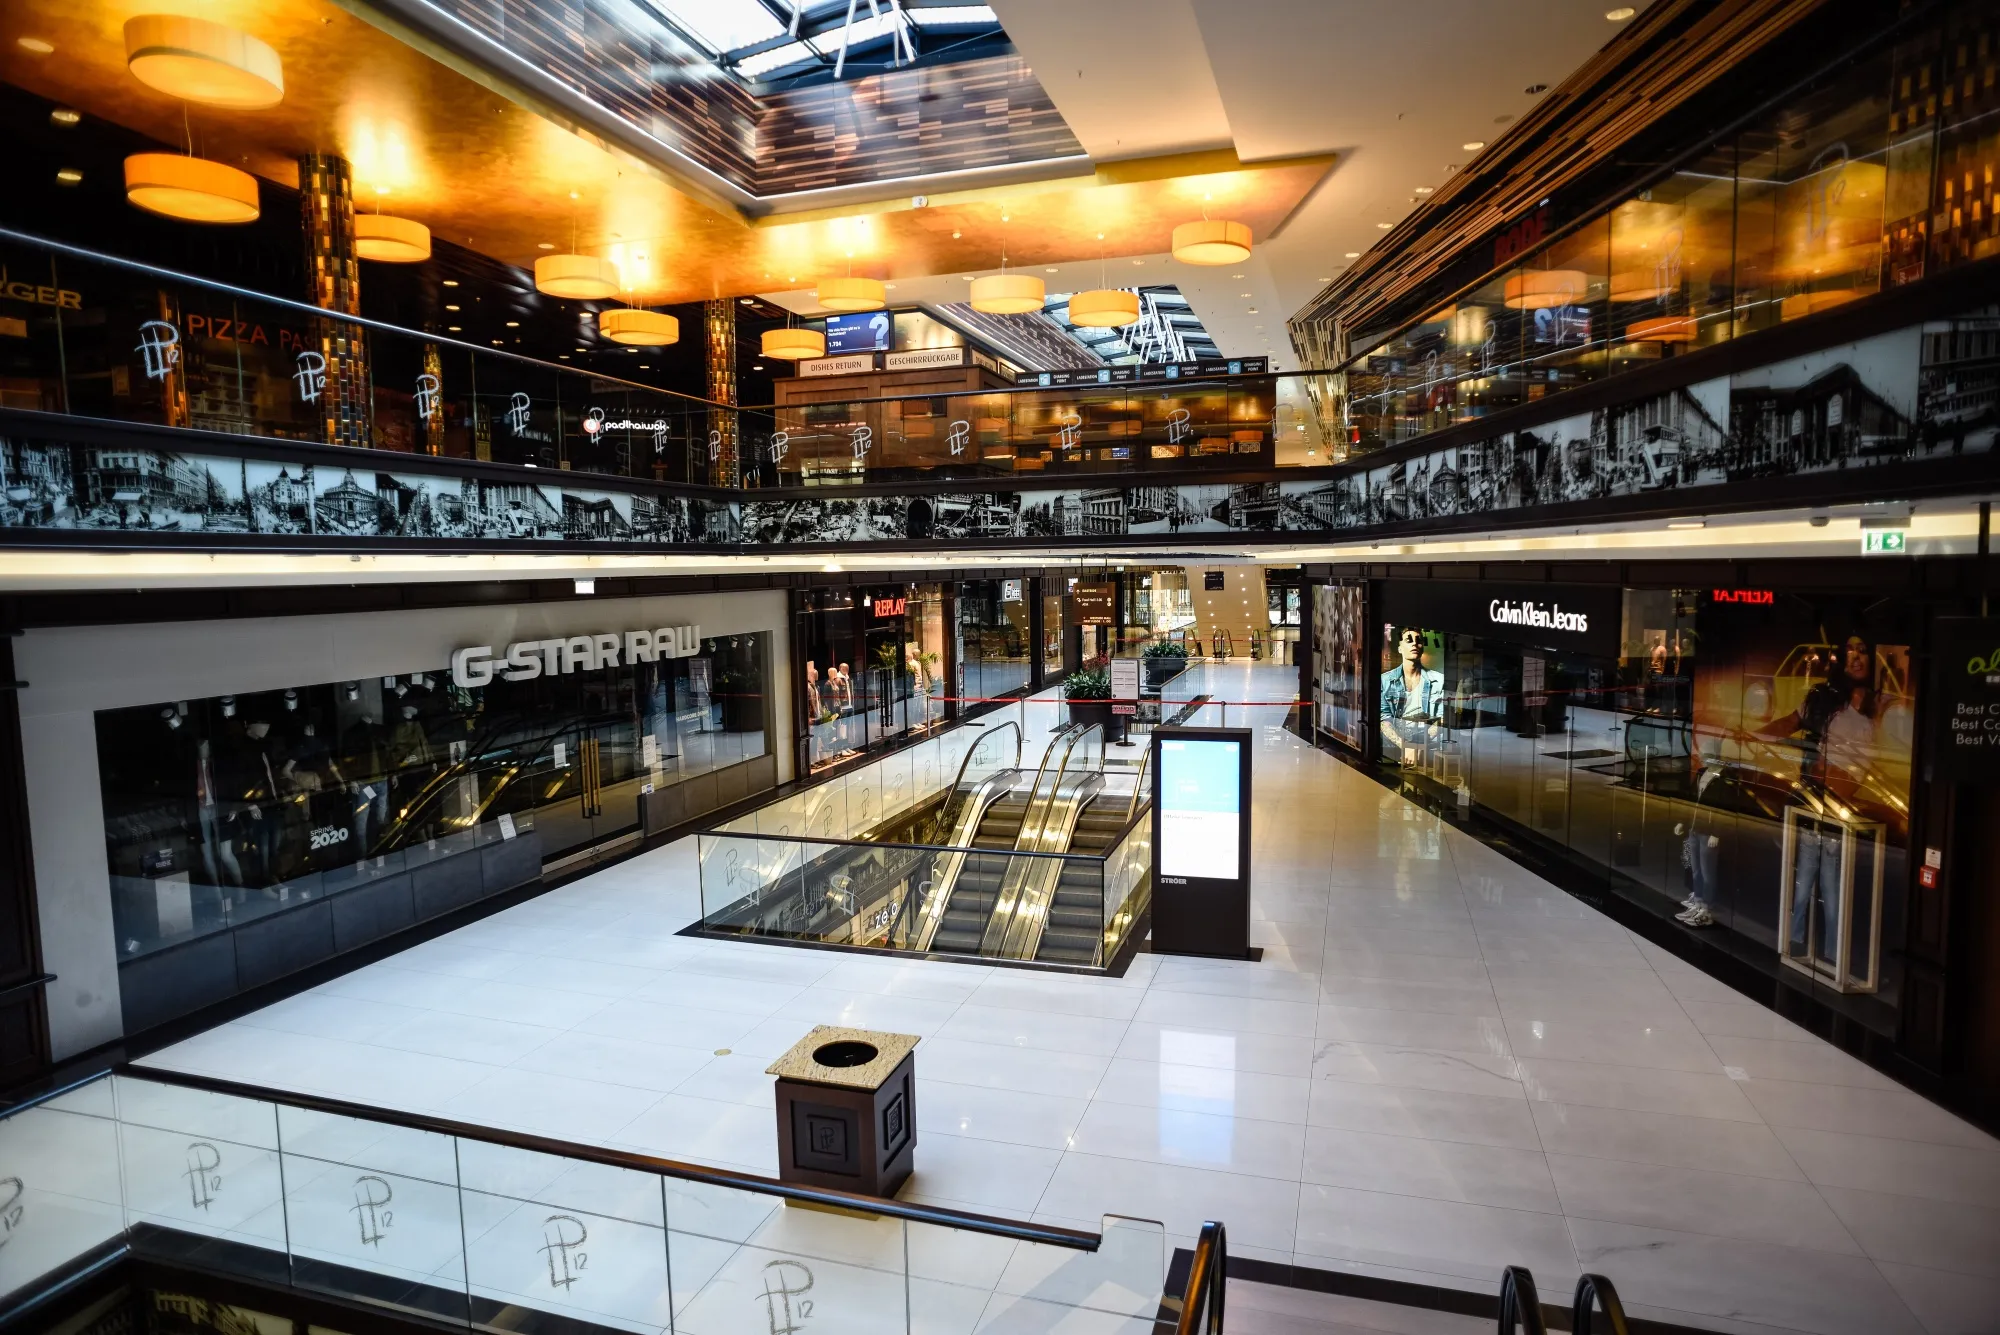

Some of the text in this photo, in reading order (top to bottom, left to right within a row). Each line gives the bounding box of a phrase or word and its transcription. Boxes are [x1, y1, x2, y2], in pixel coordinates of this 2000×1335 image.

[188, 314, 269, 346] PIZZA
[811, 360, 862, 372] DISHES RETURN
[889, 353, 960, 366] GESCHIRRRÜCKGABE
[875, 598, 906, 617] REPLAY
[1490, 599, 1588, 632] Calvin Klein Jeans
[452, 625, 701, 688] G-STAR RAW
[1957, 703, 1984, 715] Best
[1951, 718, 1979, 730] Best
[1956, 733, 1983, 745] Best
[310, 824, 334, 837] SPRING
[310, 827, 349, 850] 2020
